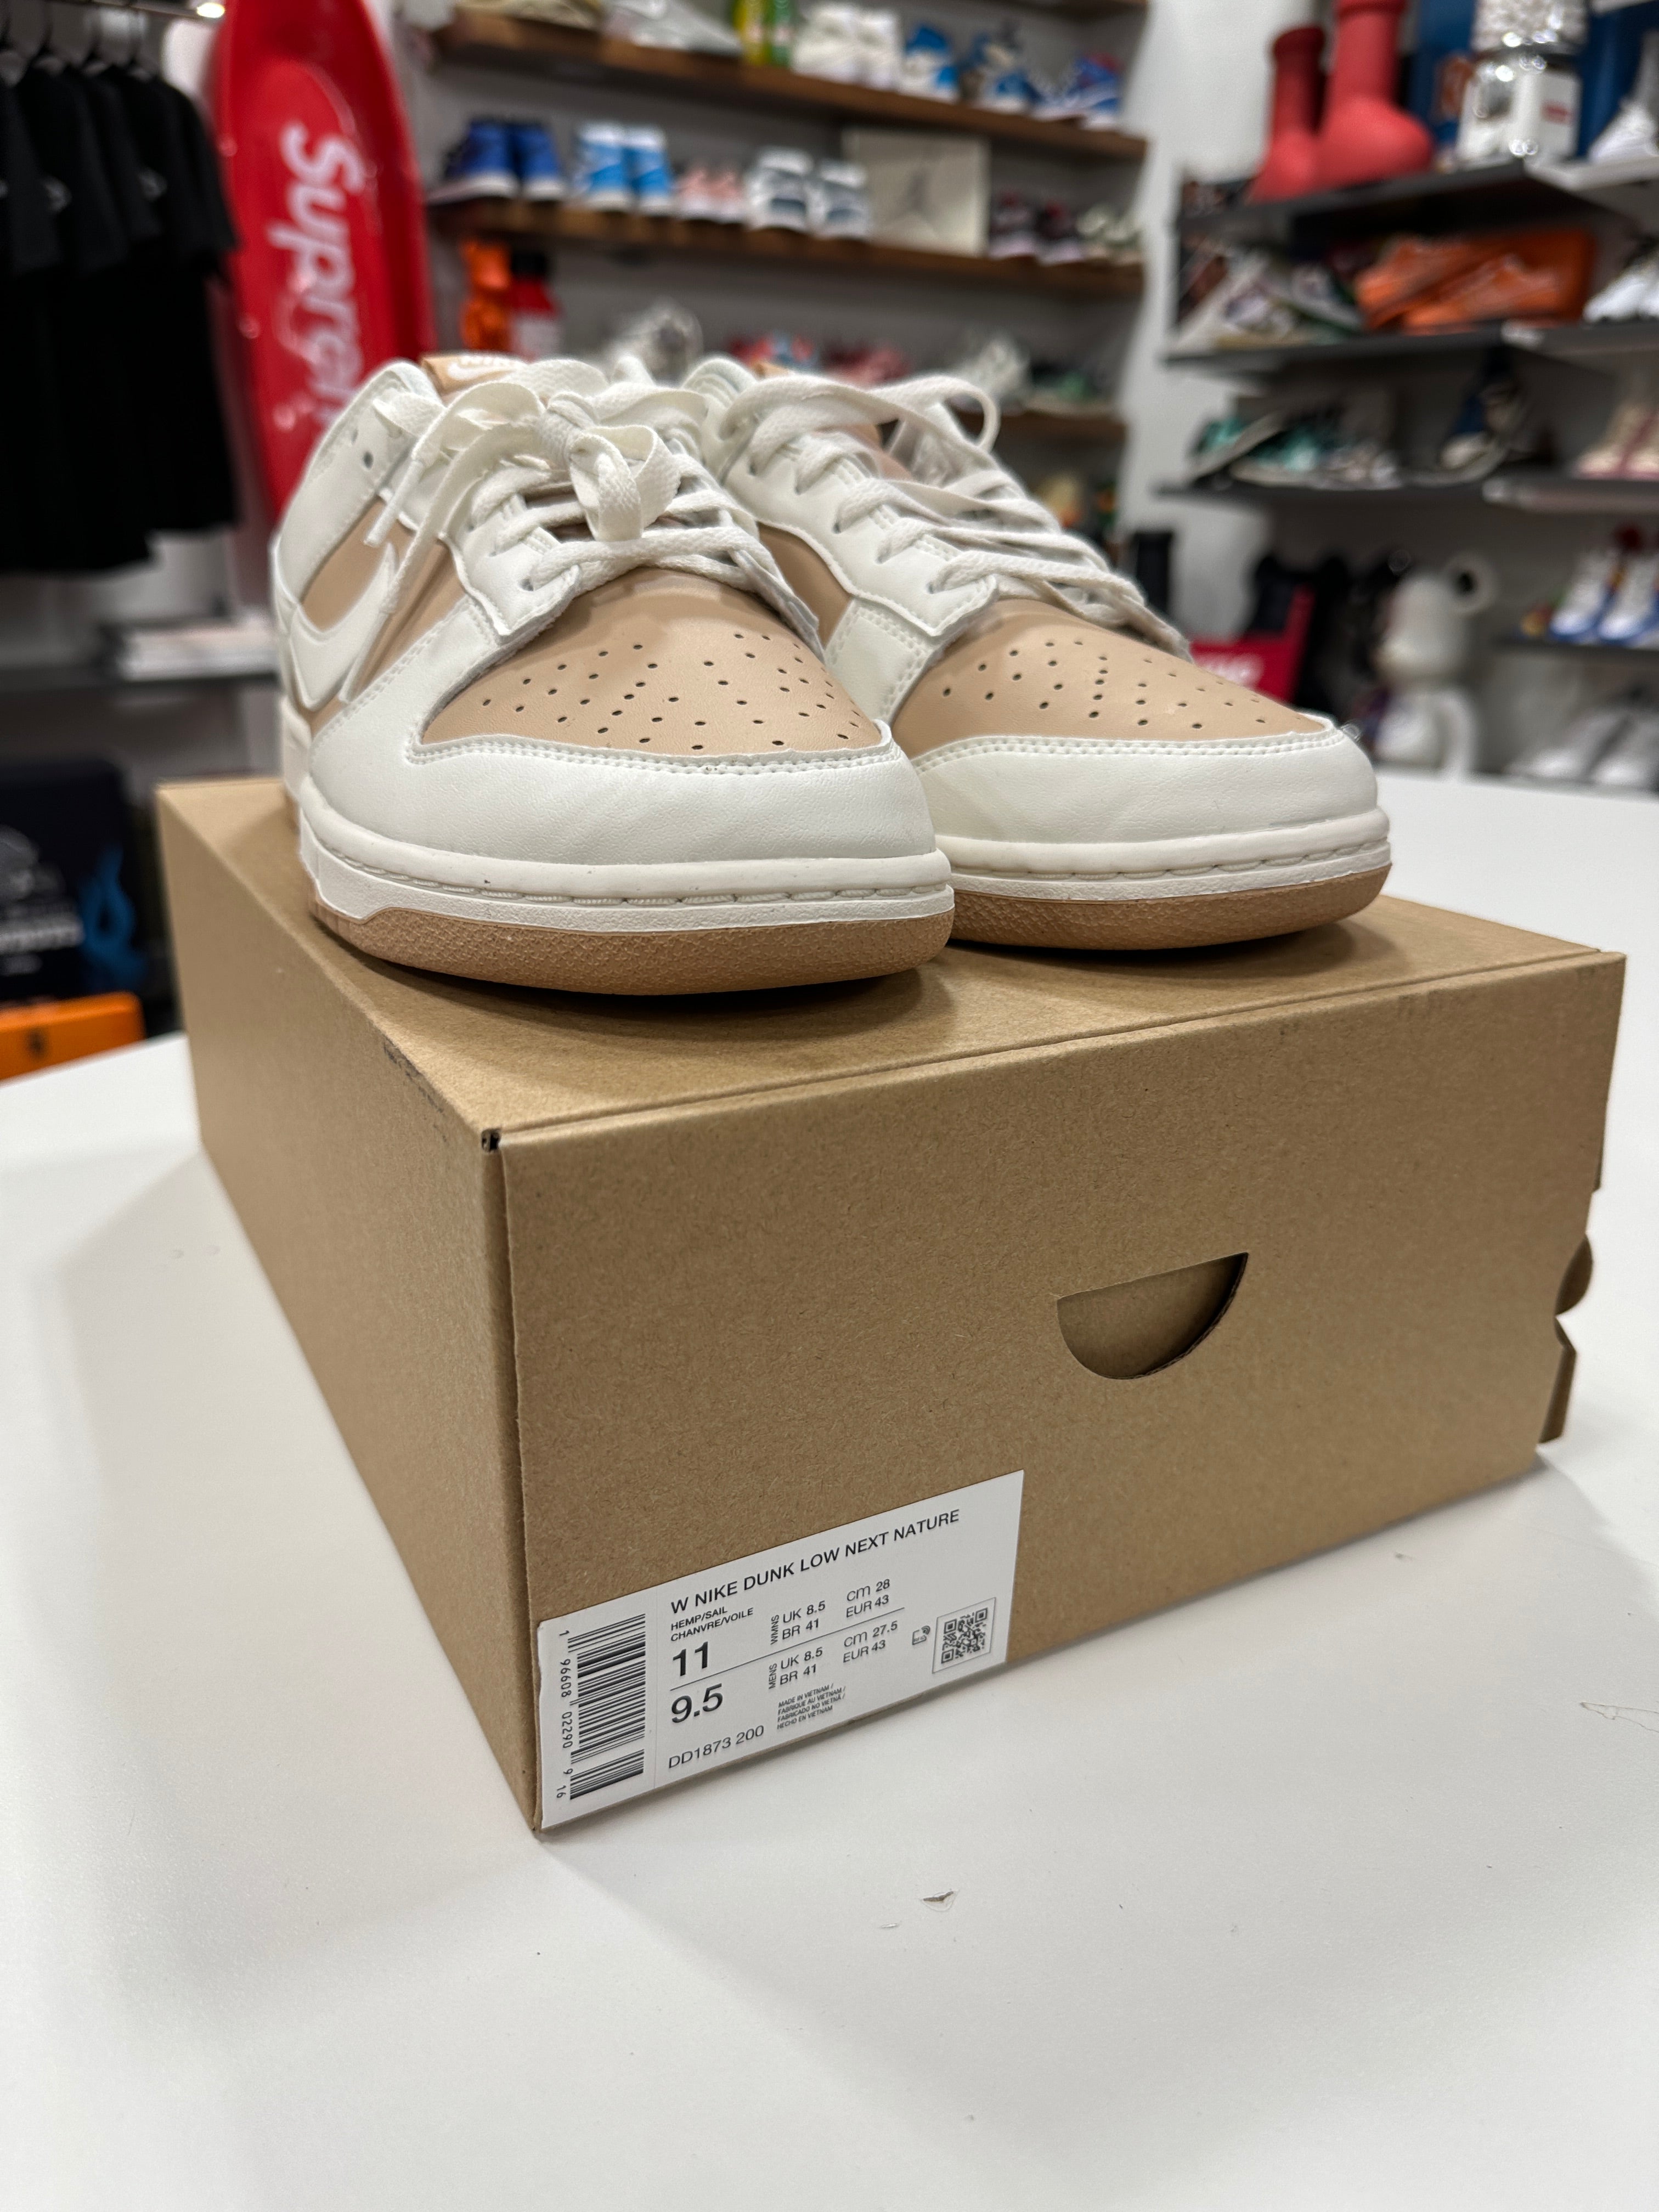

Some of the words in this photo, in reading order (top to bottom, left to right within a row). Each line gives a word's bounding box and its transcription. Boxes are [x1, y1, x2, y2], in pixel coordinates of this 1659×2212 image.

[670, 1596, 689, 1614] W
[695, 1581, 738, 1607] NIKE
[743, 1561, 795, 1591] DUNK
[800, 1547, 840, 1572] LOW
[845, 1531, 890, 1558] NEXT
[893, 1509, 960, 1542] NATURE
[846, 1585, 871, 1602] cm
[875, 1578, 890, 1593] 28
[671, 1606, 728, 1632] HEMP/SAIL
[782, 1607, 802, 1624] UK
[806, 1600, 826, 1615] 8.5
[846, 1600, 872, 1618] EUR
[874, 1594, 889, 1607] 43
[670, 1607, 754, 1642] CHANVRE/VOILE
[770, 1614, 780, 1645] WMNS
[782, 1624, 801, 1640] BR
[805, 1618, 819, 1631] 41
[843, 1631, 868, 1647] cm
[872, 1620, 898, 1639] 27.5
[673, 1641, 709, 1677] 11
[780, 1654, 799, 1670] UK
[804, 1646, 823, 1662] 8.5
[843, 1645, 869, 1663] EUR
[871, 1639, 887, 1652] 43
[560, 1658, 572, 1698] 96608
[768, 1663, 778, 1690] MENS
[779, 1670, 798, 1686] BR
[803, 1663, 817, 1676] 41
[671, 1683, 724, 1724] 9.5
[778, 1696, 795, 1708] MADE
[804, 1684, 830, 1698] VIETNAM
[778, 1700, 806, 1716] FABRIQUE
[817, 1687, 842, 1701] VIETNAM
[777, 1705, 810, 1722] FABRICADO
[777, 1718, 797, 1730] HECHO
[808, 1705, 833, 1718] VIETNAM
[562, 1711, 573, 1748] 02290
[669, 1736, 731, 1769] DD1873
[736, 1725, 764, 1745] 200
